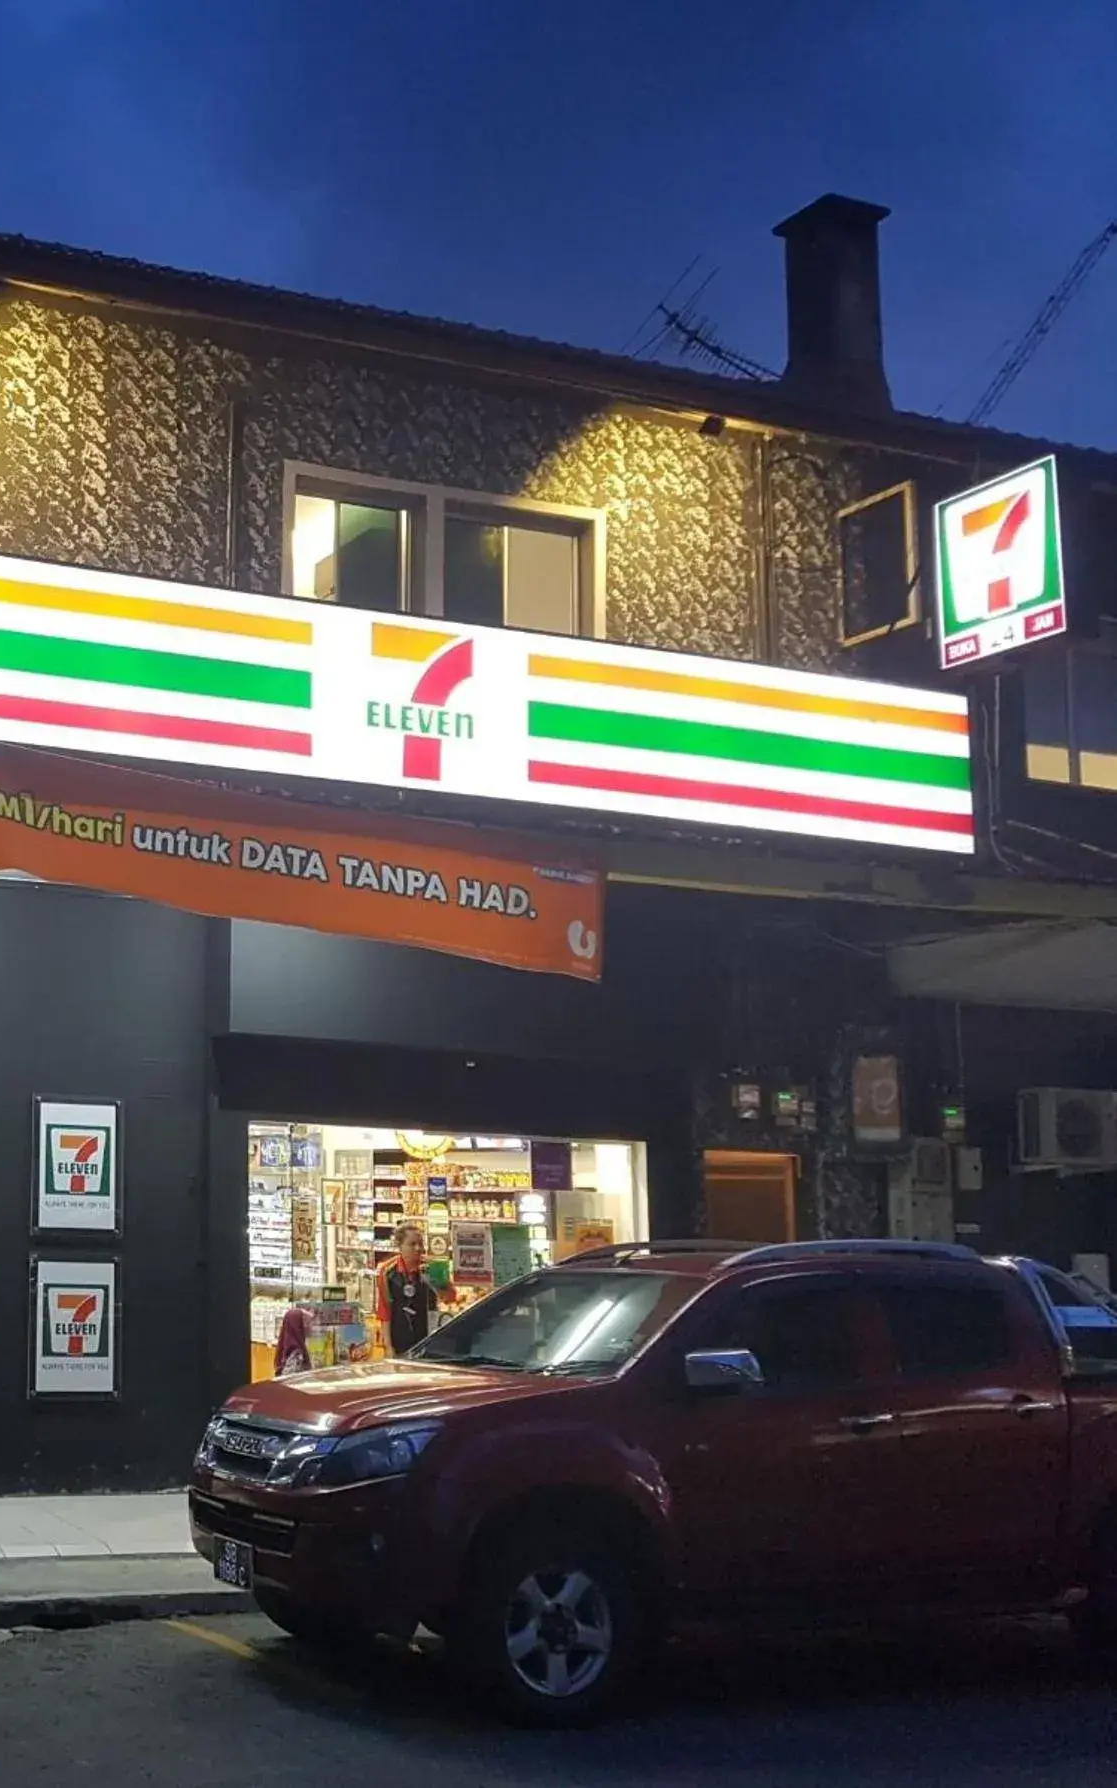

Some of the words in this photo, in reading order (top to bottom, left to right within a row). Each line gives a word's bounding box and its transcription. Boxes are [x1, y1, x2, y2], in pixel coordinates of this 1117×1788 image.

[132, 824, 232, 866] untuk
[241, 837, 328, 882] DATA
[337, 855, 448, 904] TANPA
[457, 876, 538, 919] HAD.
